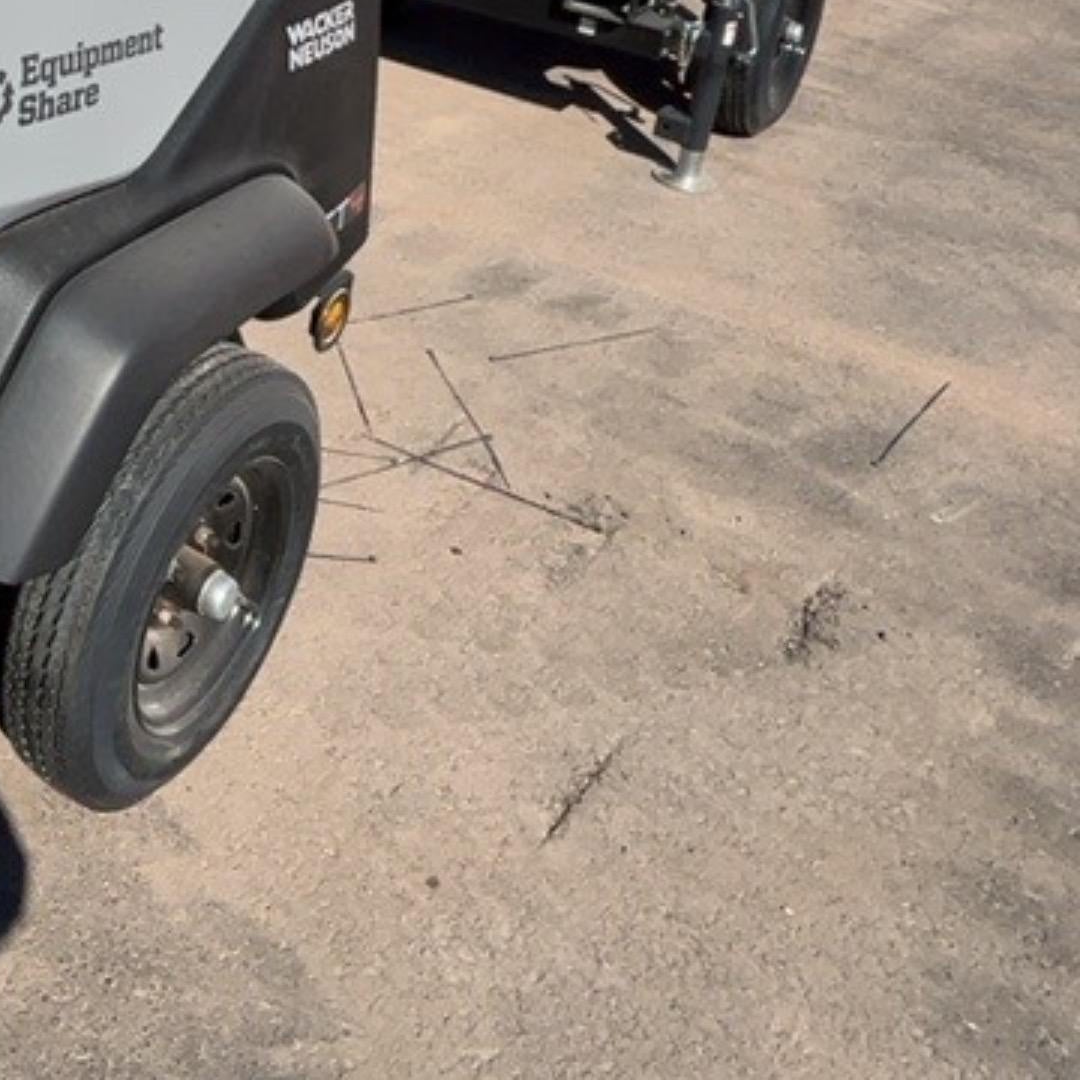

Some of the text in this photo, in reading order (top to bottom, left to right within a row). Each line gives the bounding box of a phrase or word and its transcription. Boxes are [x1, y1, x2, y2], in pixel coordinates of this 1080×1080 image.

[286, 0, 355, 46] WACKER
[289, 21, 355, 72] NEUSON
[20, 23, 164, 88] Equipment
[18, 83, 100, 127] Share
